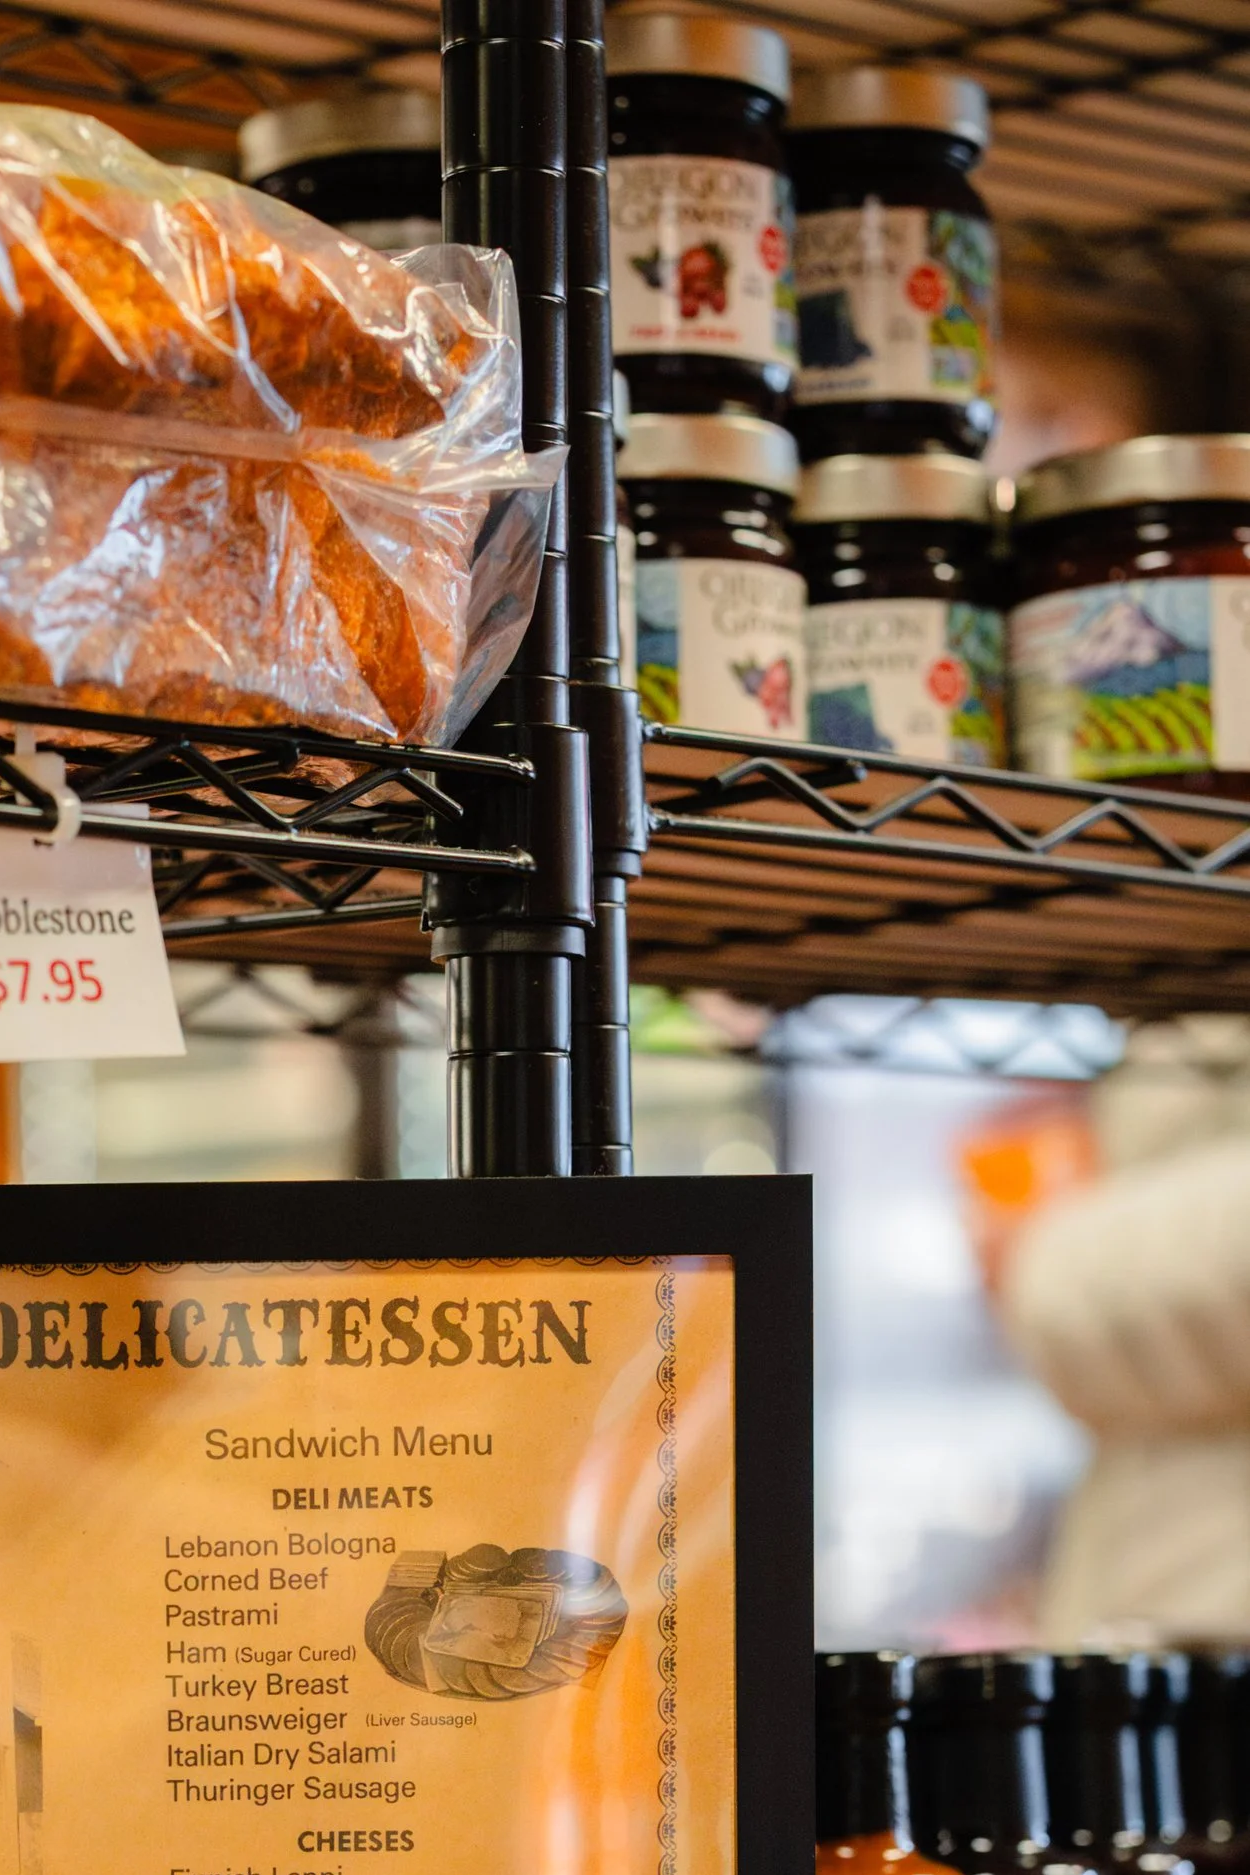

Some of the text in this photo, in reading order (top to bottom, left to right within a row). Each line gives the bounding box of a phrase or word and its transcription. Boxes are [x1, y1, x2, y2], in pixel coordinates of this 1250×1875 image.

[206, 1426, 492, 1459] Sandwich Menu
[273, 1486, 433, 1510] DELI MEATS
[166, 1533, 395, 1560] Lebanon Bologna
[165, 1567, 328, 1592] Corned Beef
[166, 1603, 277, 1627] Pastrami
[167, 1641, 356, 1666] Ham (Sugar Cured)
[165, 1673, 348, 1701] Turkey Breast
[168, 1707, 476, 1735] Braunsweiger (Liver Sausage)
[168, 1741, 395, 1770] Italian Dry Salami
[166, 1776, 415, 1806] Thuringer Sausage
[298, 1830, 414, 1852] CHEESES
